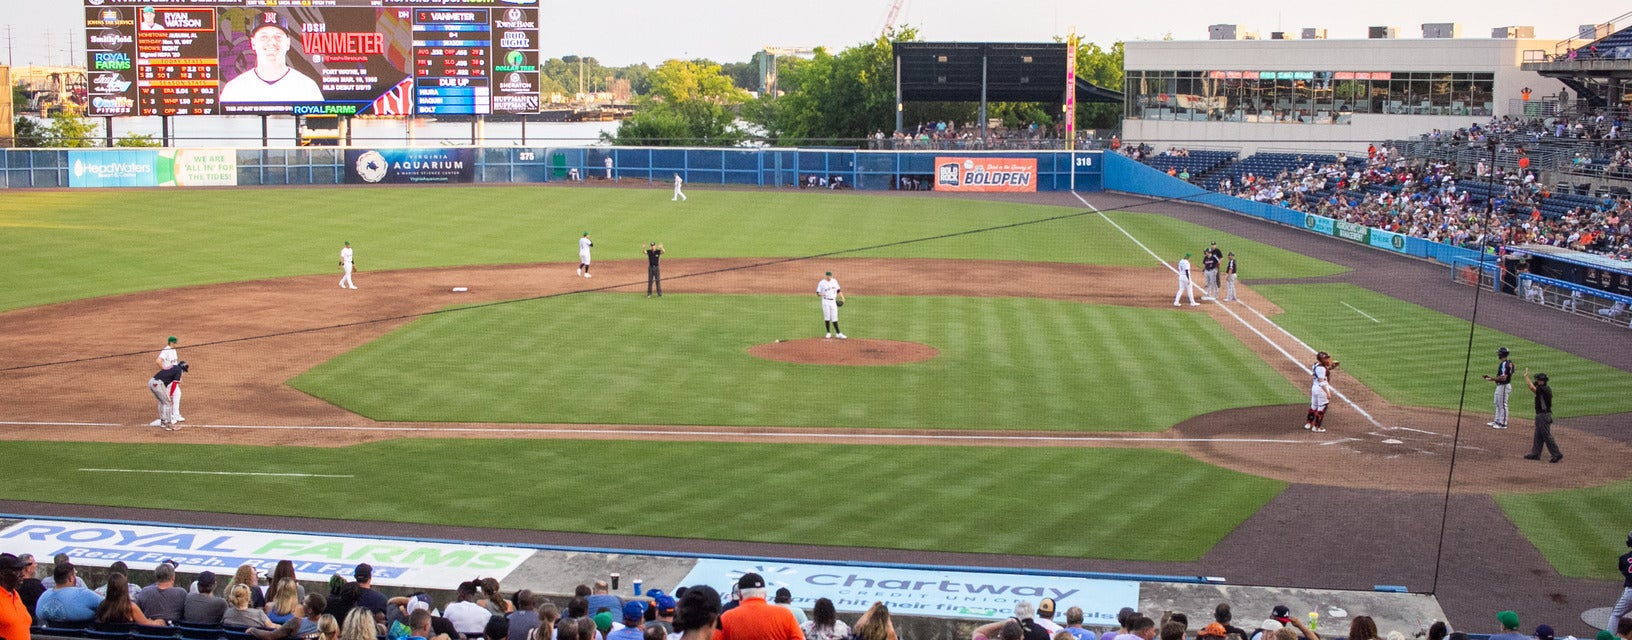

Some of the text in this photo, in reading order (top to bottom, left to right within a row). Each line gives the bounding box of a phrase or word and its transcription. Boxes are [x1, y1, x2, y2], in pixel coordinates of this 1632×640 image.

[164, 12, 188, 20] RYAN
[398, 11, 409, 19] DH
[430, 13, 475, 21] VANMETER
[164, 20, 201, 28] WATSON
[302, 23, 326, 32] JOSH
[90, 36, 132, 45] Smithfield
[505, 32, 525, 40] BUD
[302, 32, 384, 54] VANMETER
[95, 53, 130, 61] ROYAL
[95, 61, 131, 70] FARMS
[439, 78, 470, 86] DUE UP
[520, 152, 535, 161] 375
[394, 161, 463, 170] AQUARIUM
[1076, 158, 1092, 166] 318
[84, 163, 151, 173] HeadWaters
[964, 172, 1030, 185] BOLDPEN
[1, 525, 523, 570] ROYAL FARMS
[68, 548, 390, 578] Real Fresh. Rel Fat.
[804, 574, 1081, 602] Chartway
[838, 590, 928, 599] CREDIT
[838, 598, 870, 606] hit
[885, 601, 931, 609] heir
